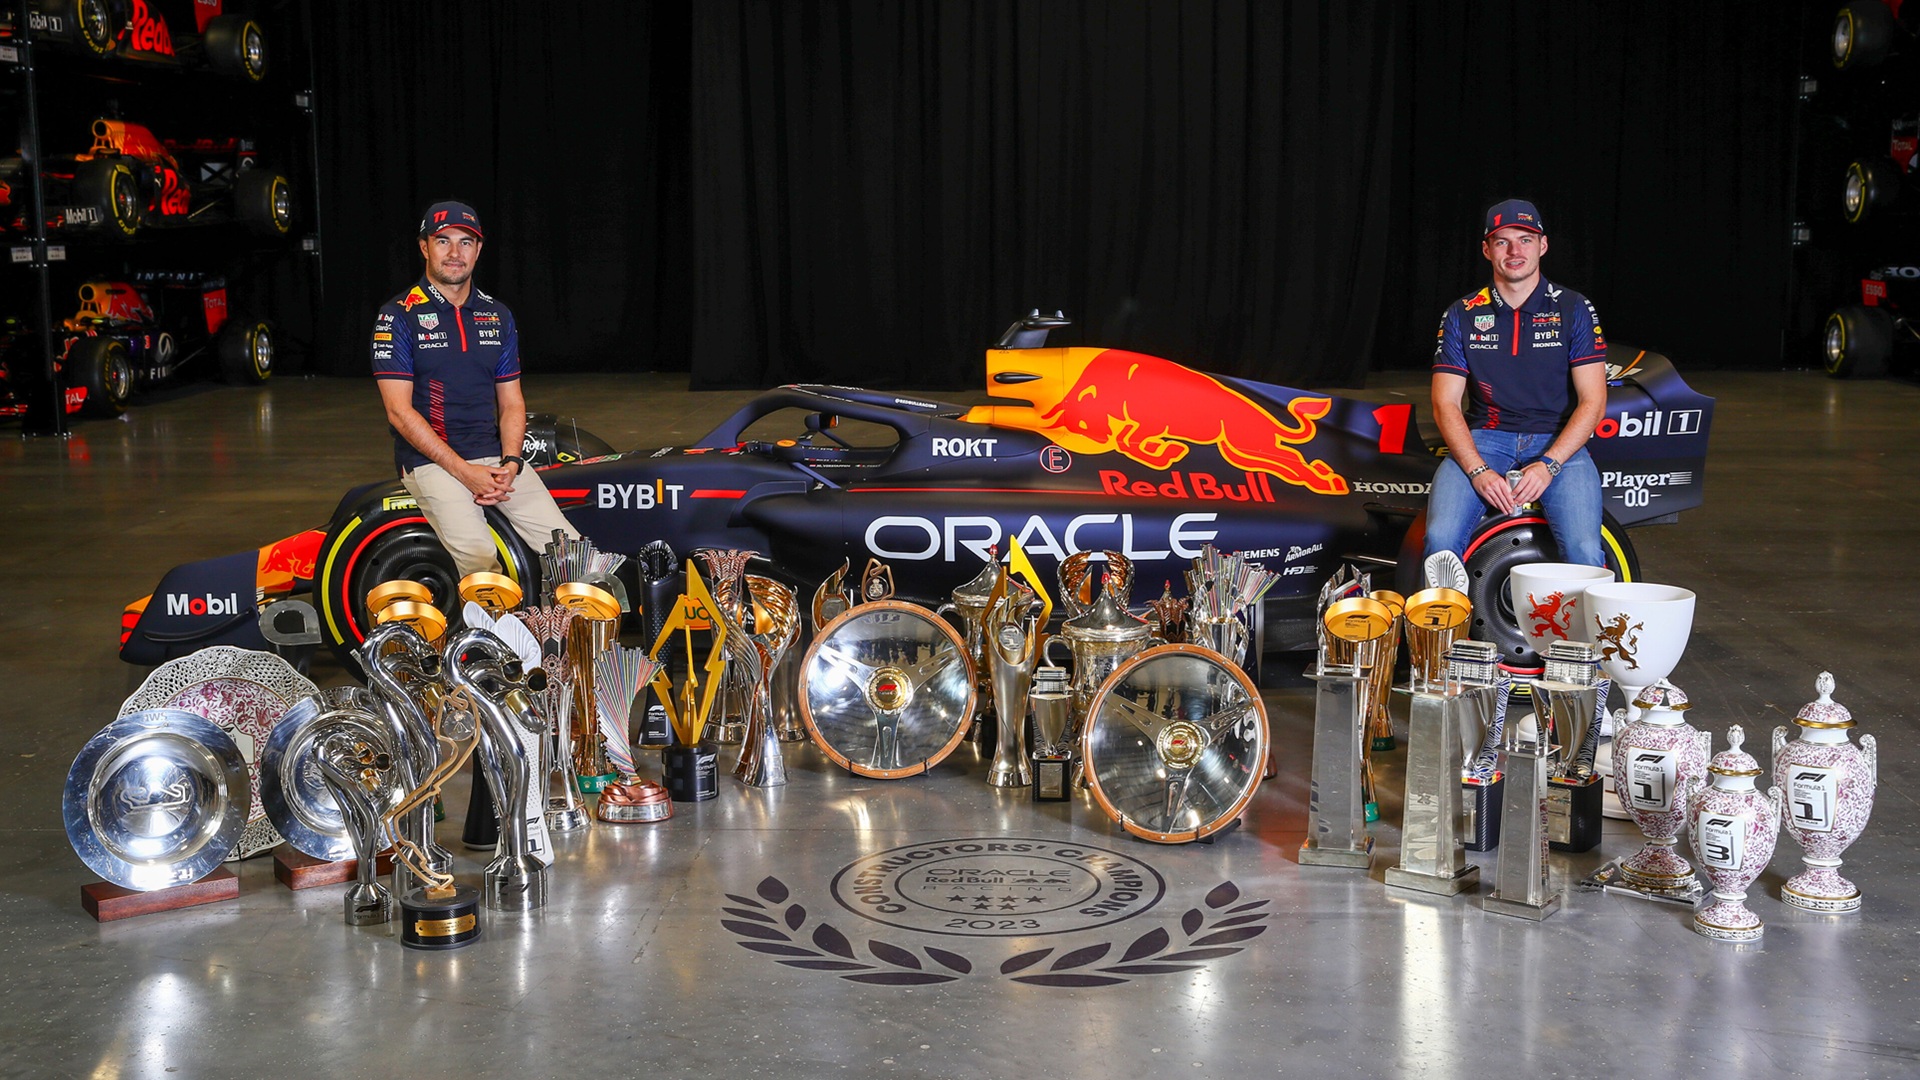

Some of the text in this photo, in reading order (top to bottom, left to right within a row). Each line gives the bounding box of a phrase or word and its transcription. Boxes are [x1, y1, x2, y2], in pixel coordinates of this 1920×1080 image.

[433, 210, 448, 223] 11
[1494, 213, 1502, 226] 1
[427, 284, 445, 304] zoom
[1491, 288, 1503, 307] zoom
[418, 332, 439, 341] Mobil
[479, 329, 499, 338] BYBIT
[1469, 333, 1490, 341] Mobil
[1534, 329, 1560, 340] BYBIT
[1372, 404, 1412, 454] 1
[1590, 411, 1663, 439] obil
[932, 437, 998, 457] ROKT
[1049, 448, 1064, 470] E
[1098, 470, 1276, 503] Red Bull
[1601, 471, 1671, 490] Player
[597, 479, 685, 510] BYBIT
[1624, 489, 1650, 507] 0.0
[864, 513, 1219, 562] ORACLE
[166, 592, 238, 616] Mobil
[1633, 763, 1660, 772] Formula
[1793, 782, 1821, 791] Formula
[1706, 842, 1730, 860] 3
[925, 876, 1004, 884] Red Bull
[927, 868, 1071, 877] ORACLE
[1054, 849, 1144, 918] CHAMPIONS
[945, 918, 1041, 930] 2023
